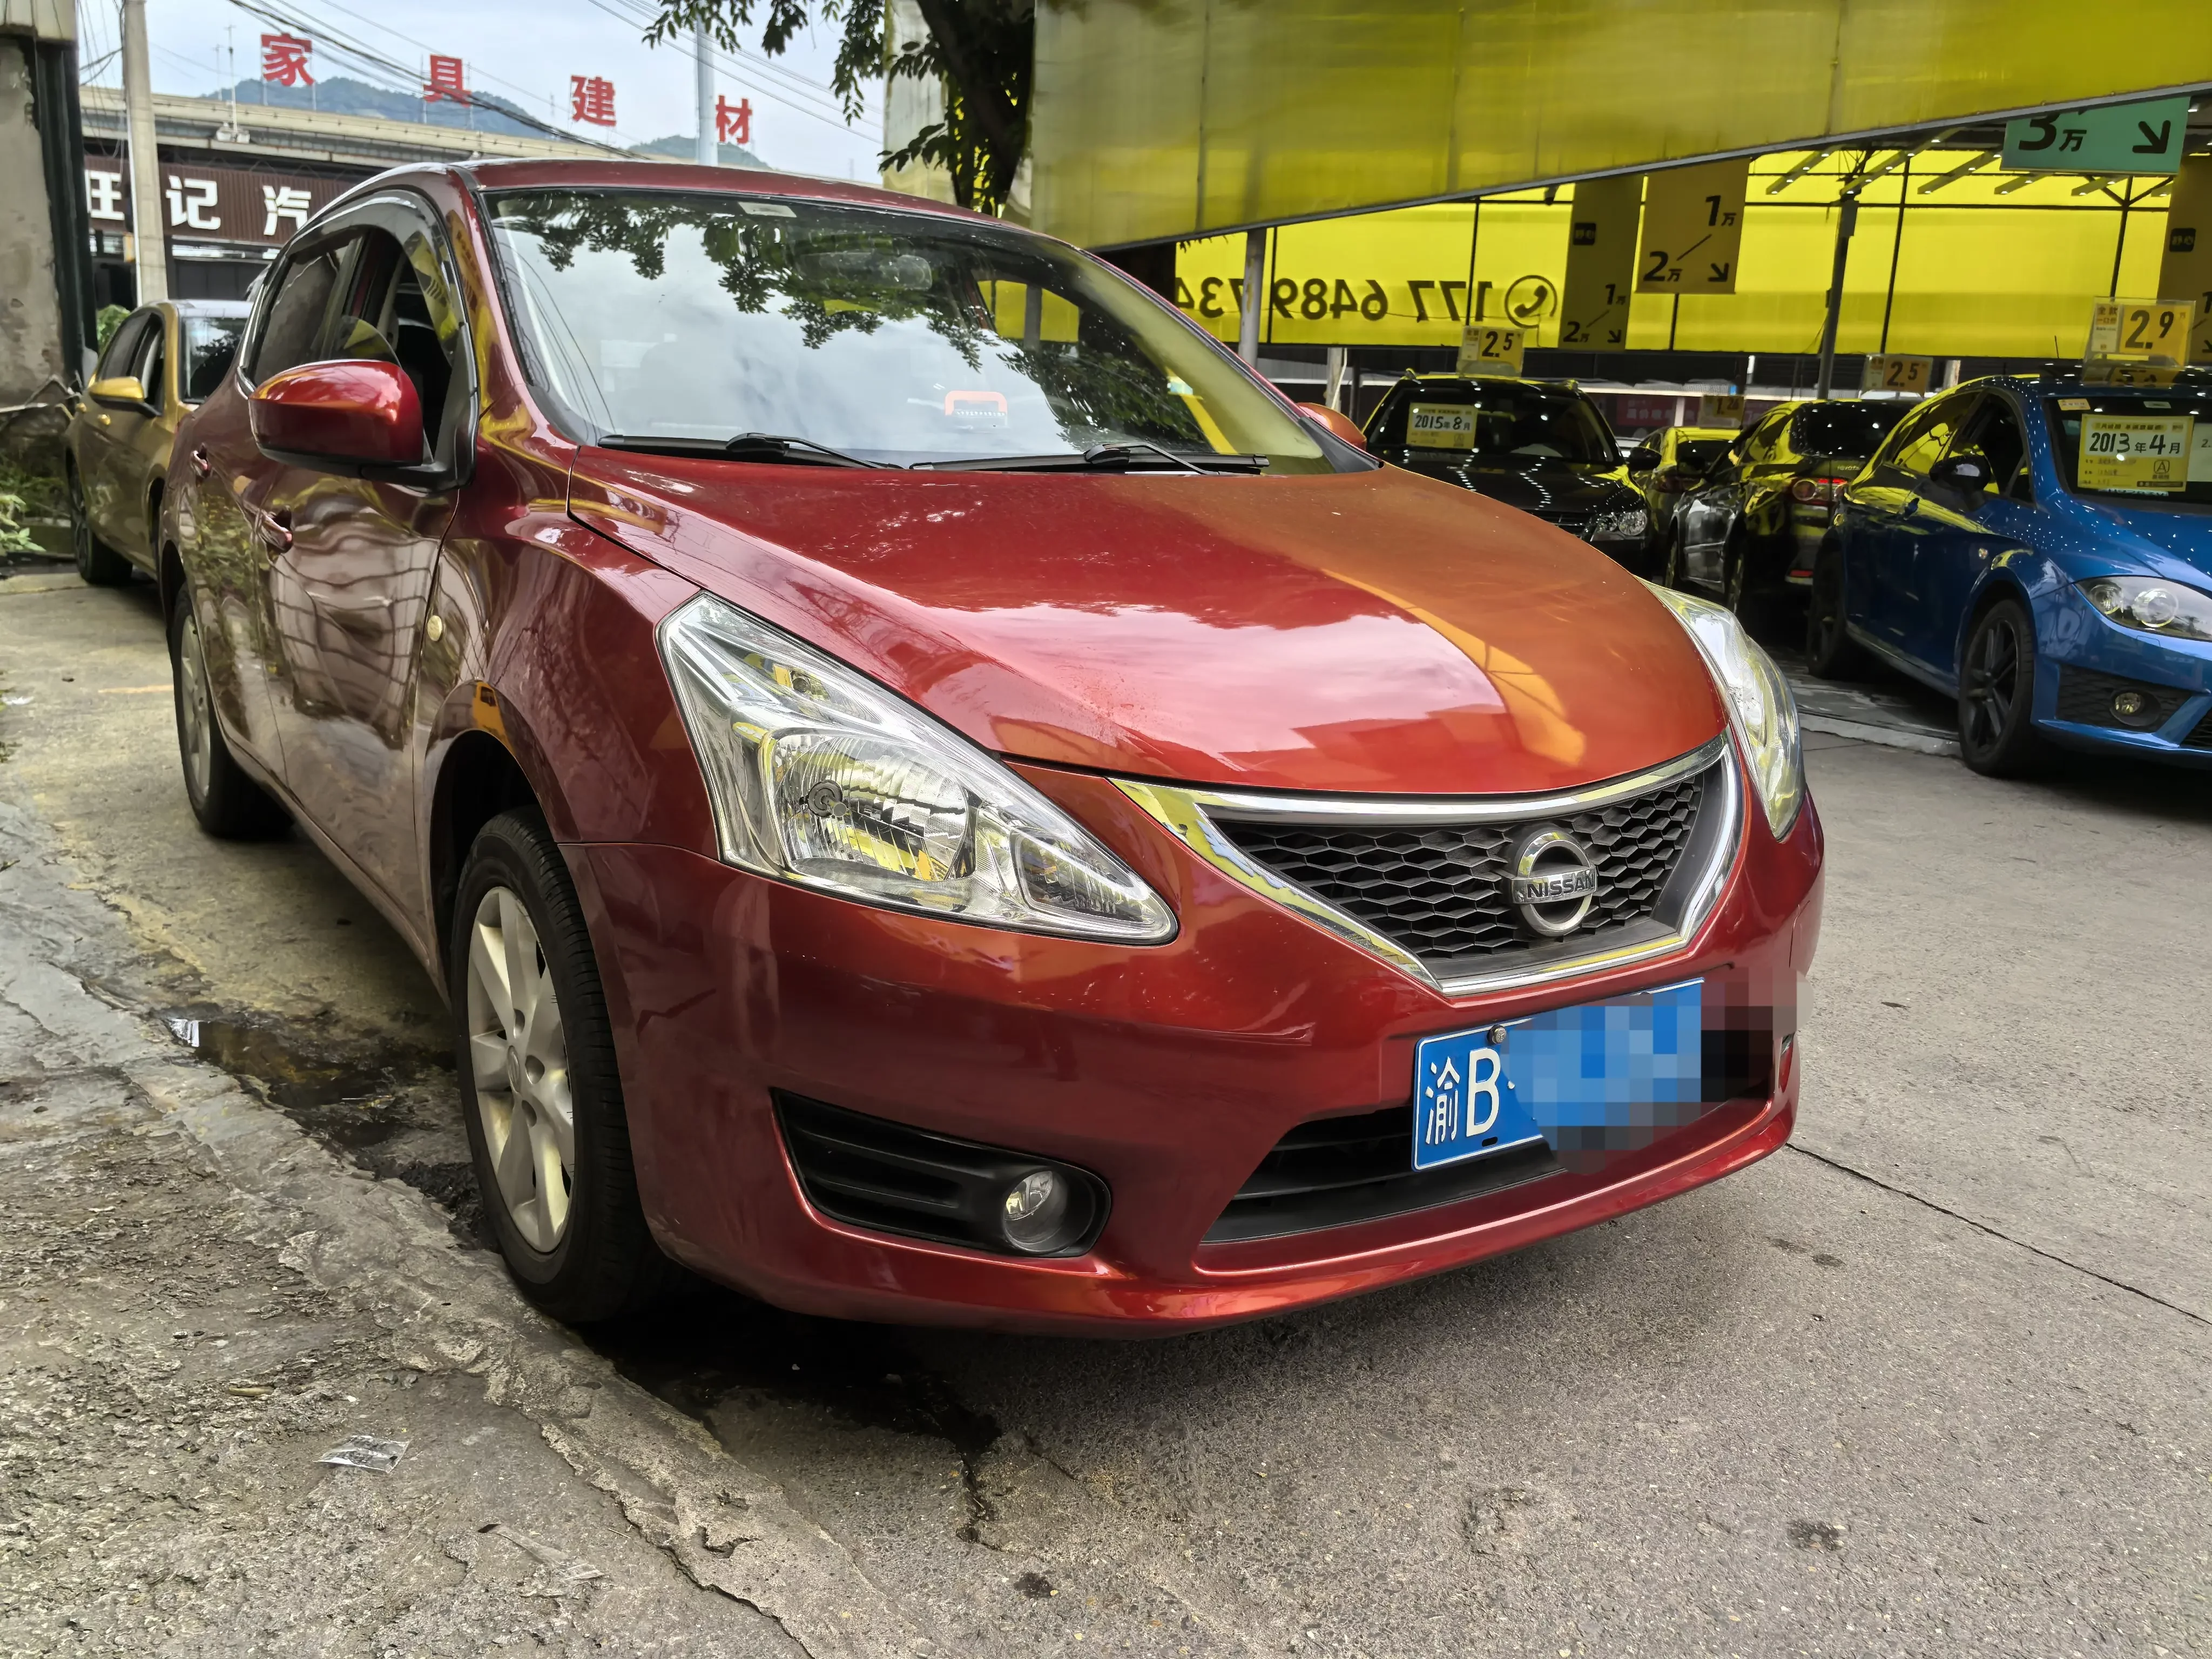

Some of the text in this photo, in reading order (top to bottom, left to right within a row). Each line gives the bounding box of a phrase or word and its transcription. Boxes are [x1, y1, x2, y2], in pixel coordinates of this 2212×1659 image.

[261, 33, 752, 144] 家具建材
[1705, 195, 1737, 226] 1万
[1643, 251, 1683, 282] 2万
[2125, 309, 2174, 350] 2.9
[1482, 331, 1514, 358] 2.5
[1887, 361, 1920, 387] 2.5
[2089, 433, 2180, 455] 2013年4月
[1527, 872, 1594, 898] NISSAN
